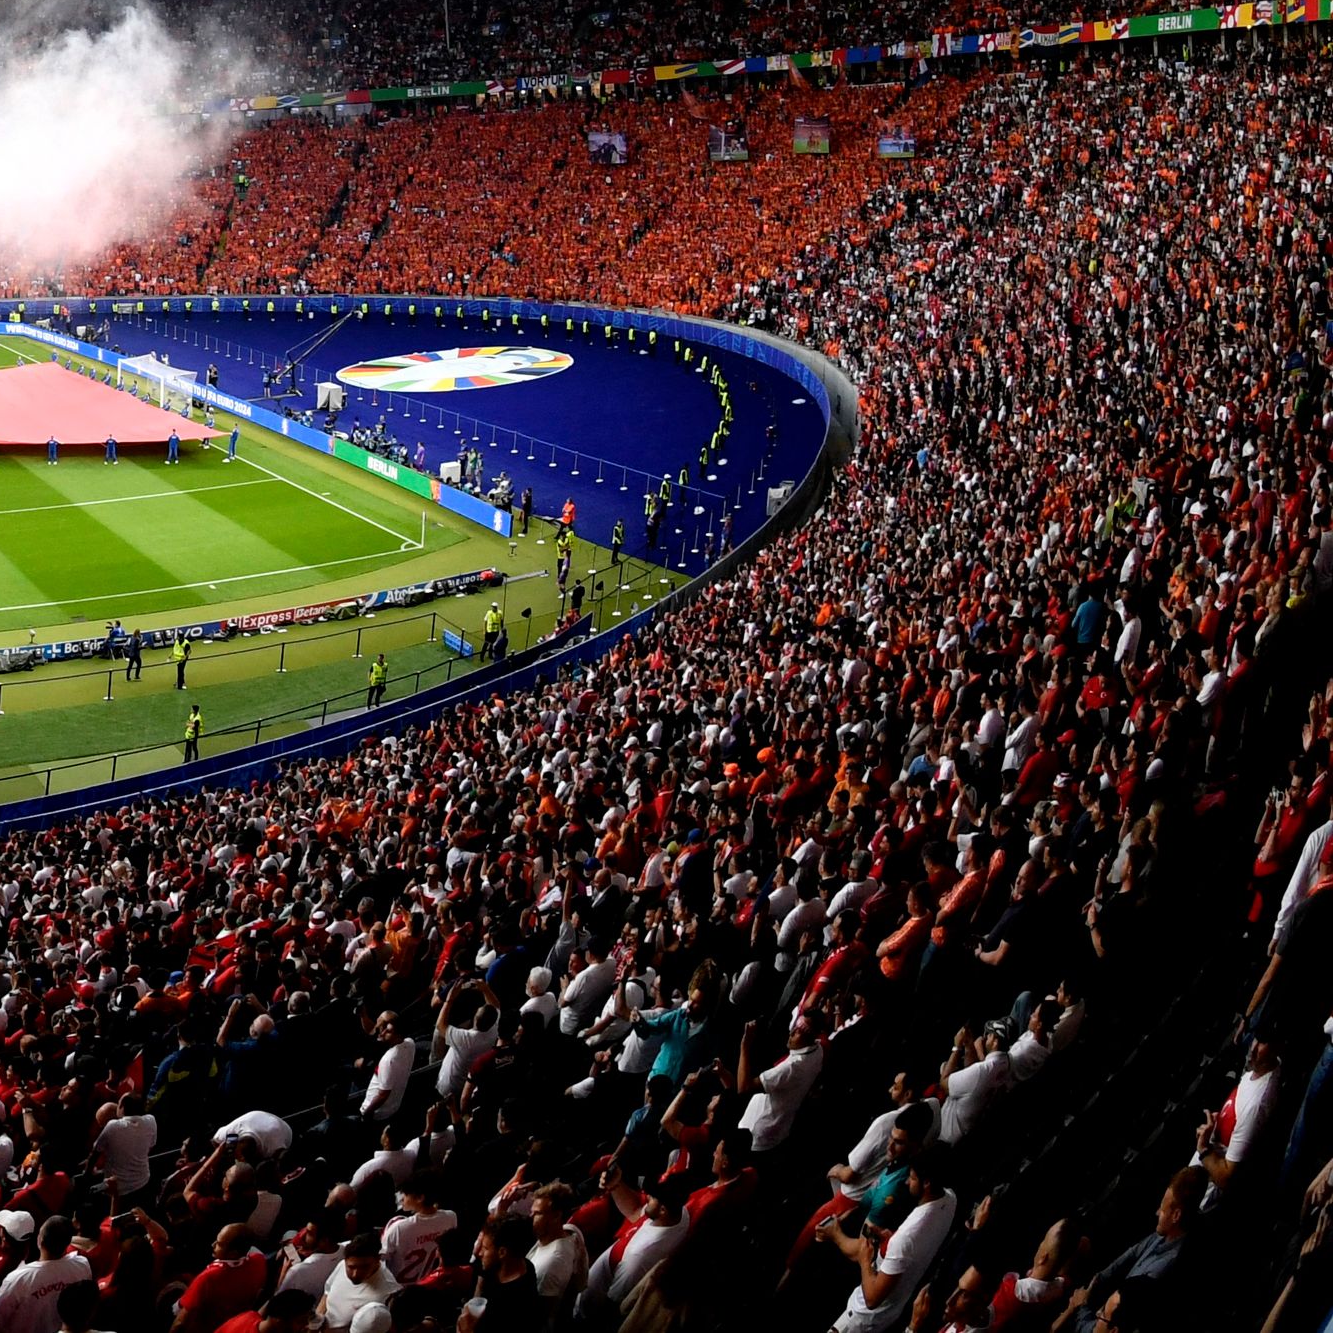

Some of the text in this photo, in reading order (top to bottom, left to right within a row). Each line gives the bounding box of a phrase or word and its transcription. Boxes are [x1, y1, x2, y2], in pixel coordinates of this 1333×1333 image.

[1158, 15, 1192, 31] BERLIN
[524, 75, 566, 87] VORTUM
[234, 400, 252, 417] 2024
[367, 456, 398, 480] BERLIN
